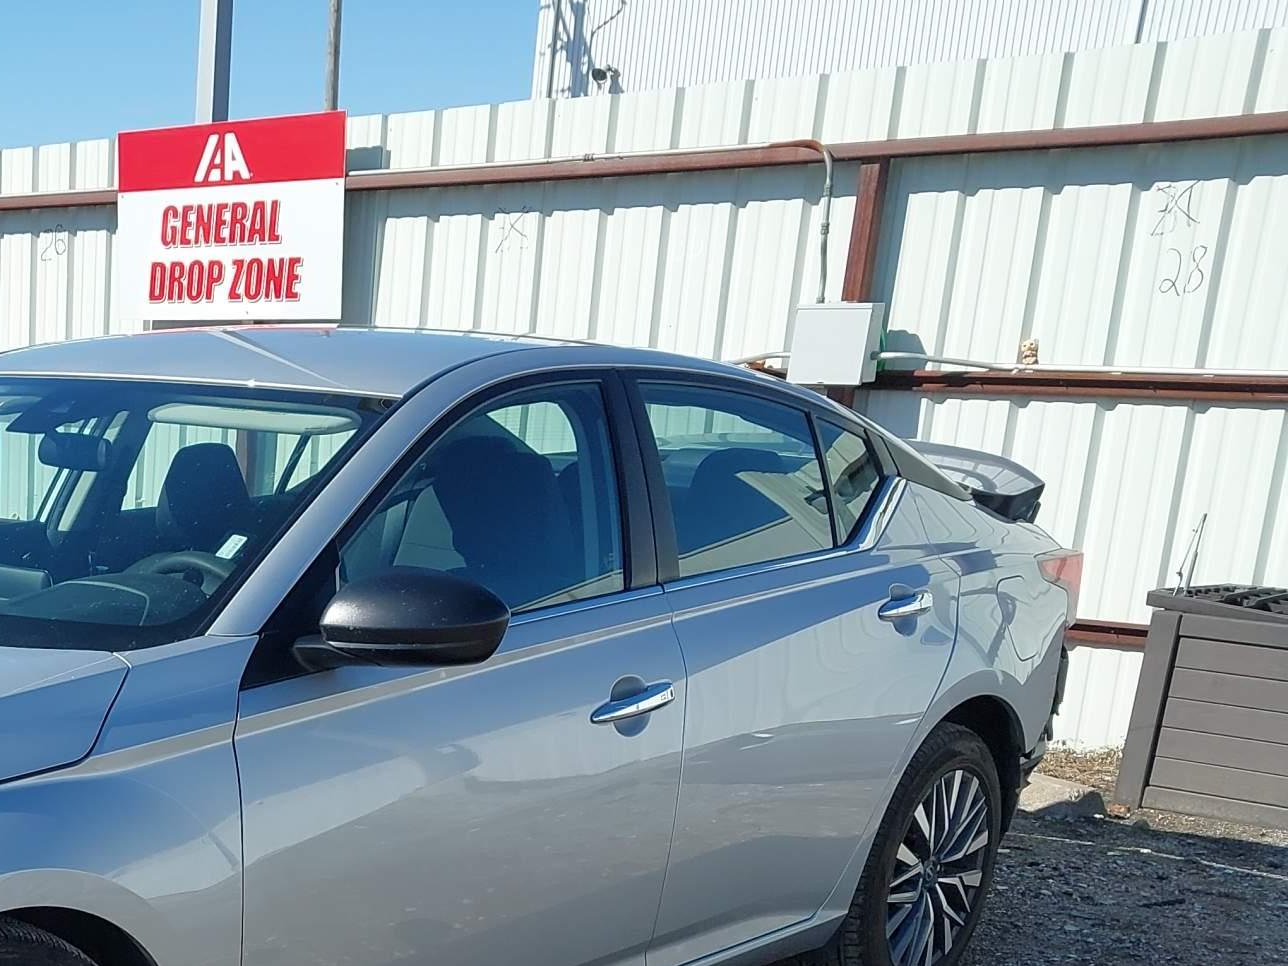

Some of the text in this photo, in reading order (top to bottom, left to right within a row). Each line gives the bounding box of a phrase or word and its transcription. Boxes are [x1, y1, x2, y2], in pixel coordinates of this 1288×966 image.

[160, 199, 281, 248] GENERAL
[148, 256, 304, 304] DROP ZONE
[1158, 244, 1209, 297] 28
